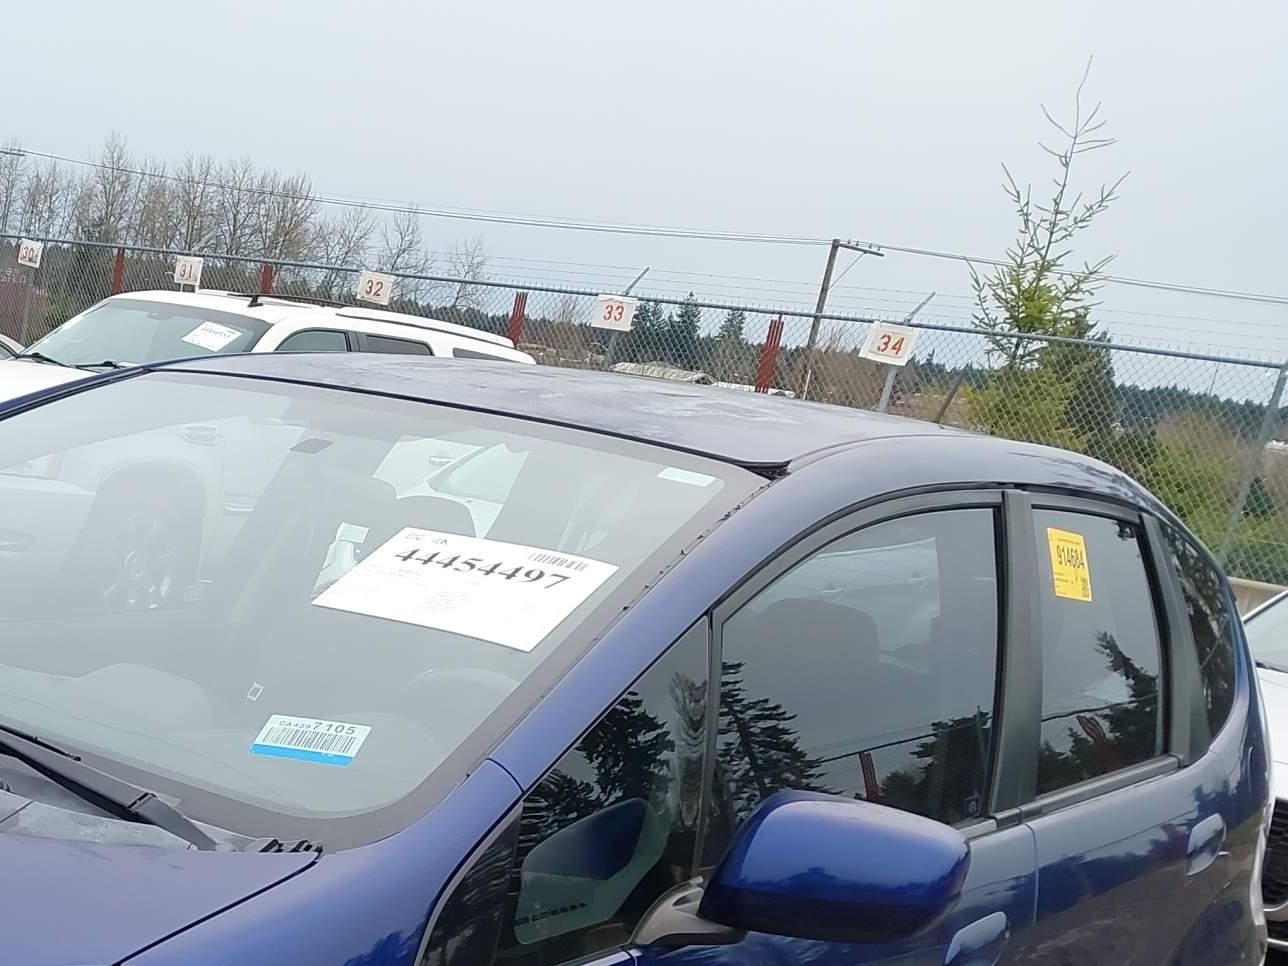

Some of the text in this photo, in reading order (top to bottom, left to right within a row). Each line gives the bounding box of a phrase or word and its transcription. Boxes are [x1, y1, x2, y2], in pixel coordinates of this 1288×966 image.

[22, 246, 35, 262] 30
[179, 262, 194, 280] 31
[364, 279, 384, 297] 32
[602, 304, 625, 323] 33
[877, 333, 905, 356] 34
[394, 548, 571, 589] 44454497
